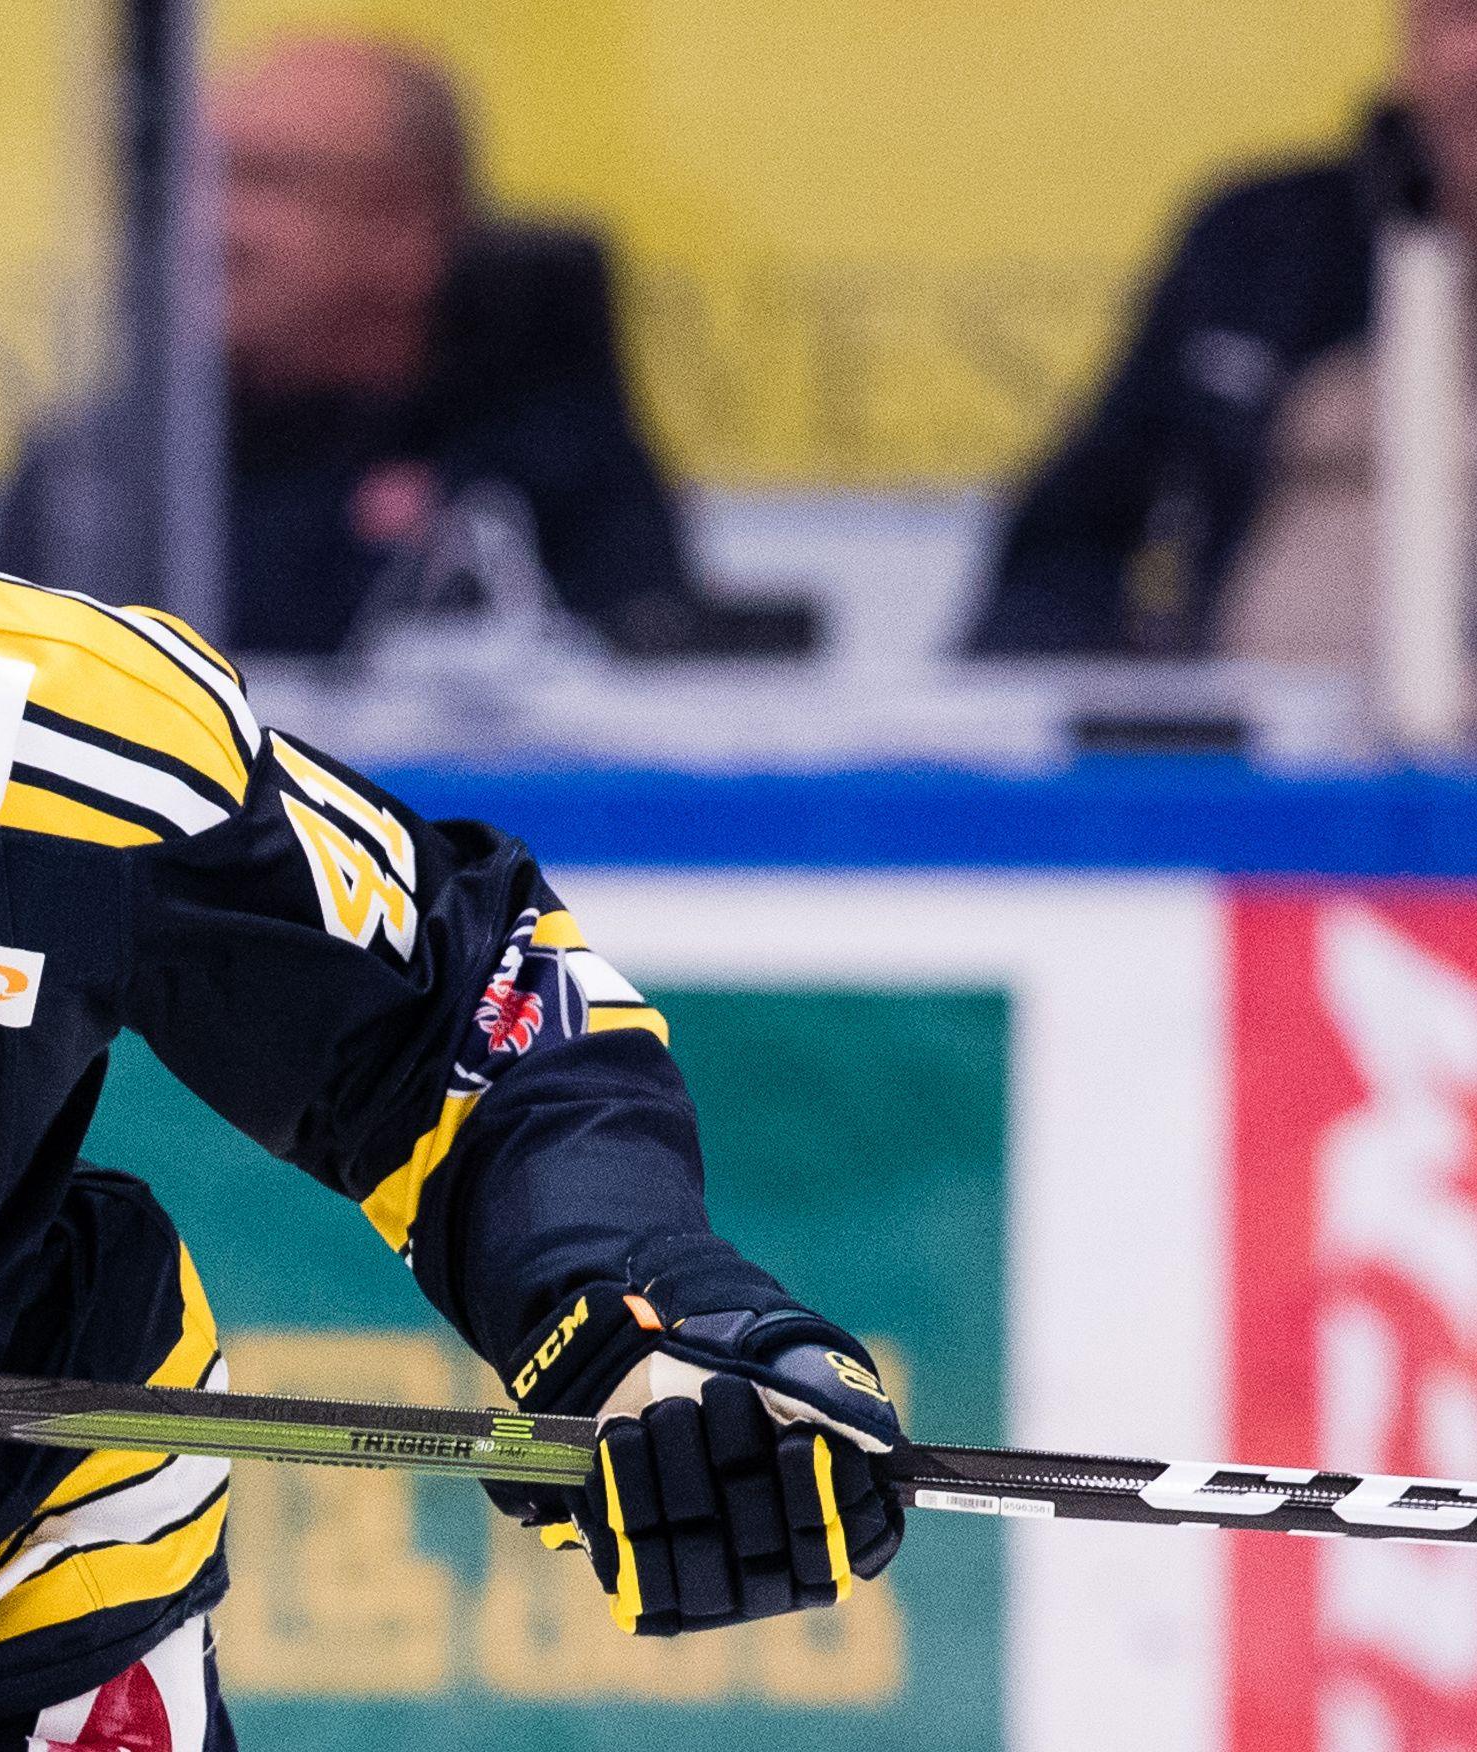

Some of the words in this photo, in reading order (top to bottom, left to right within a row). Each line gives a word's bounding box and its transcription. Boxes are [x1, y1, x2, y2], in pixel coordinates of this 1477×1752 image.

[269, 730, 418, 963] 41
[511, 1296, 590, 1399] CCM
[349, 1431, 470, 1459] TRIGGER
